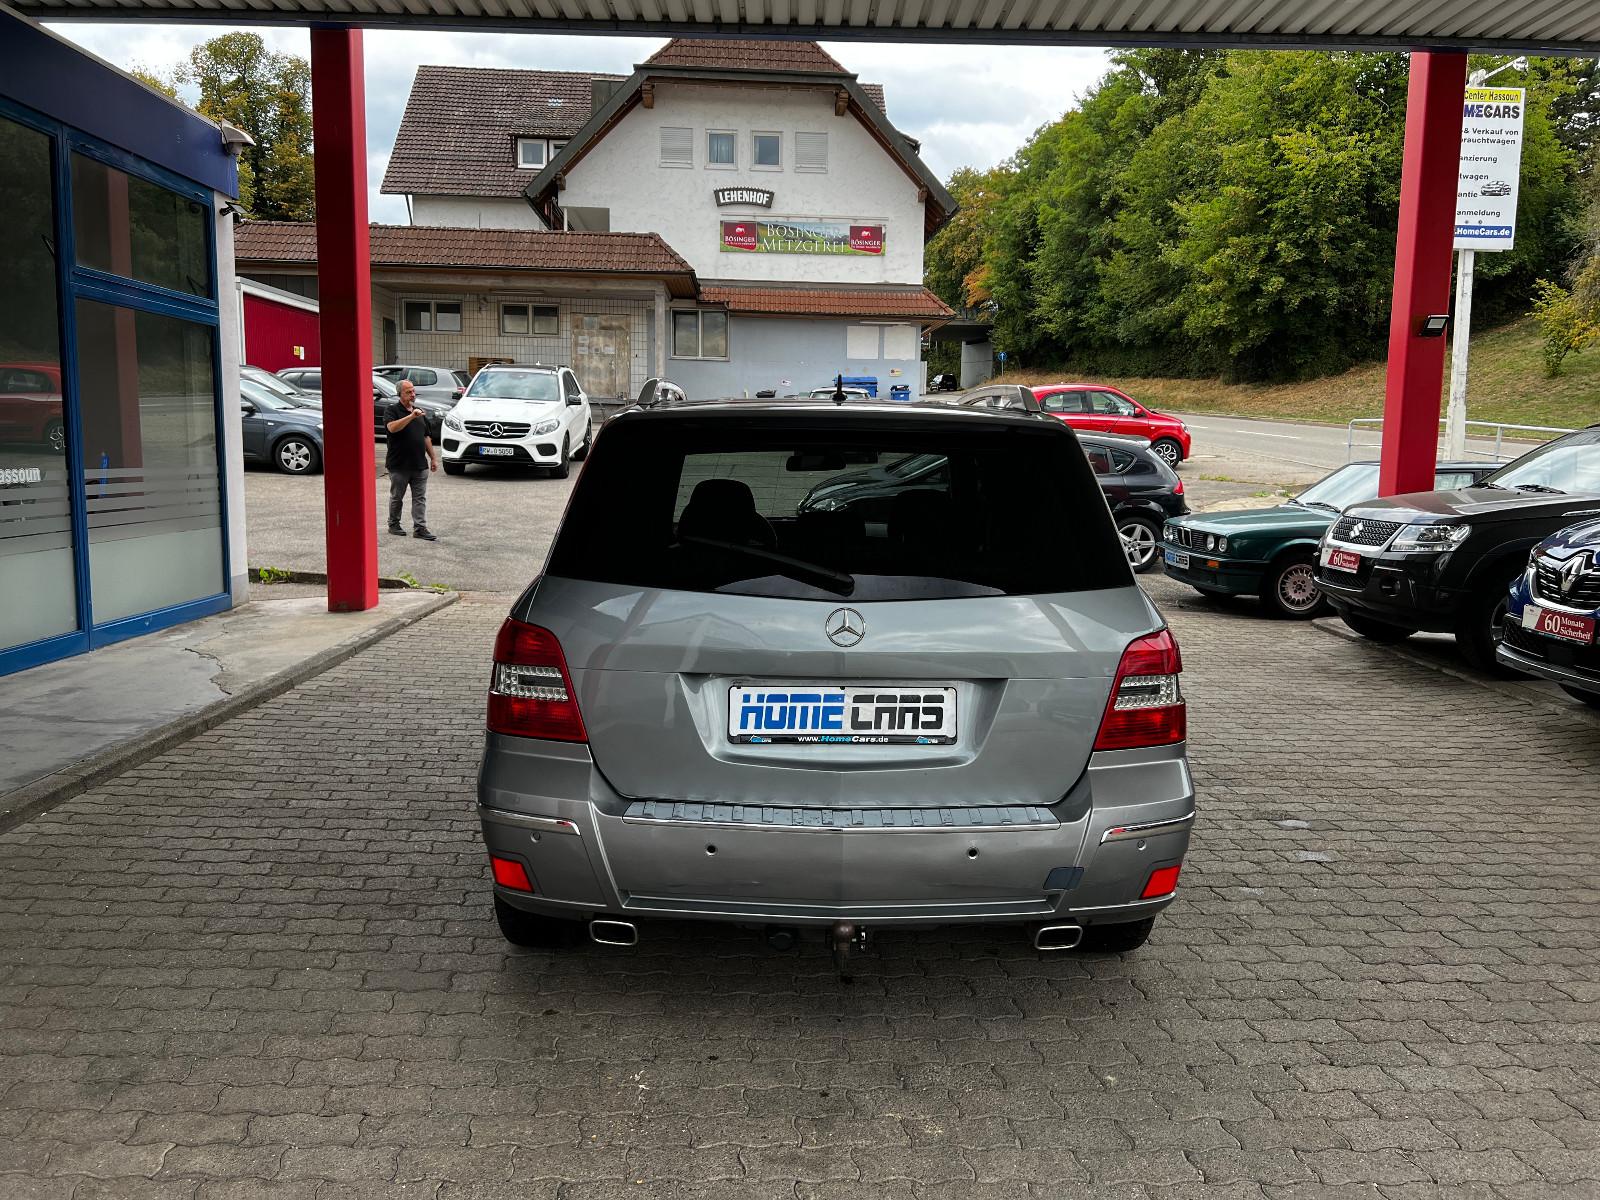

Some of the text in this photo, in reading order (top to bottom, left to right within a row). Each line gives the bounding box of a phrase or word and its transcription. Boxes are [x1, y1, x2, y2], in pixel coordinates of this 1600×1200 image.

[1465, 90, 1518, 101] Center Hassoun
[719, 190, 770, 204] LEHENHOF
[762, 237, 844, 253] METZGEREI
[1333, 552, 1343, 566] 60
[1544, 613, 1585, 633] 60 Monate
[740, 693, 945, 731] HOME CARS
[797, 735, 889, 744] www.HomeCars.de
